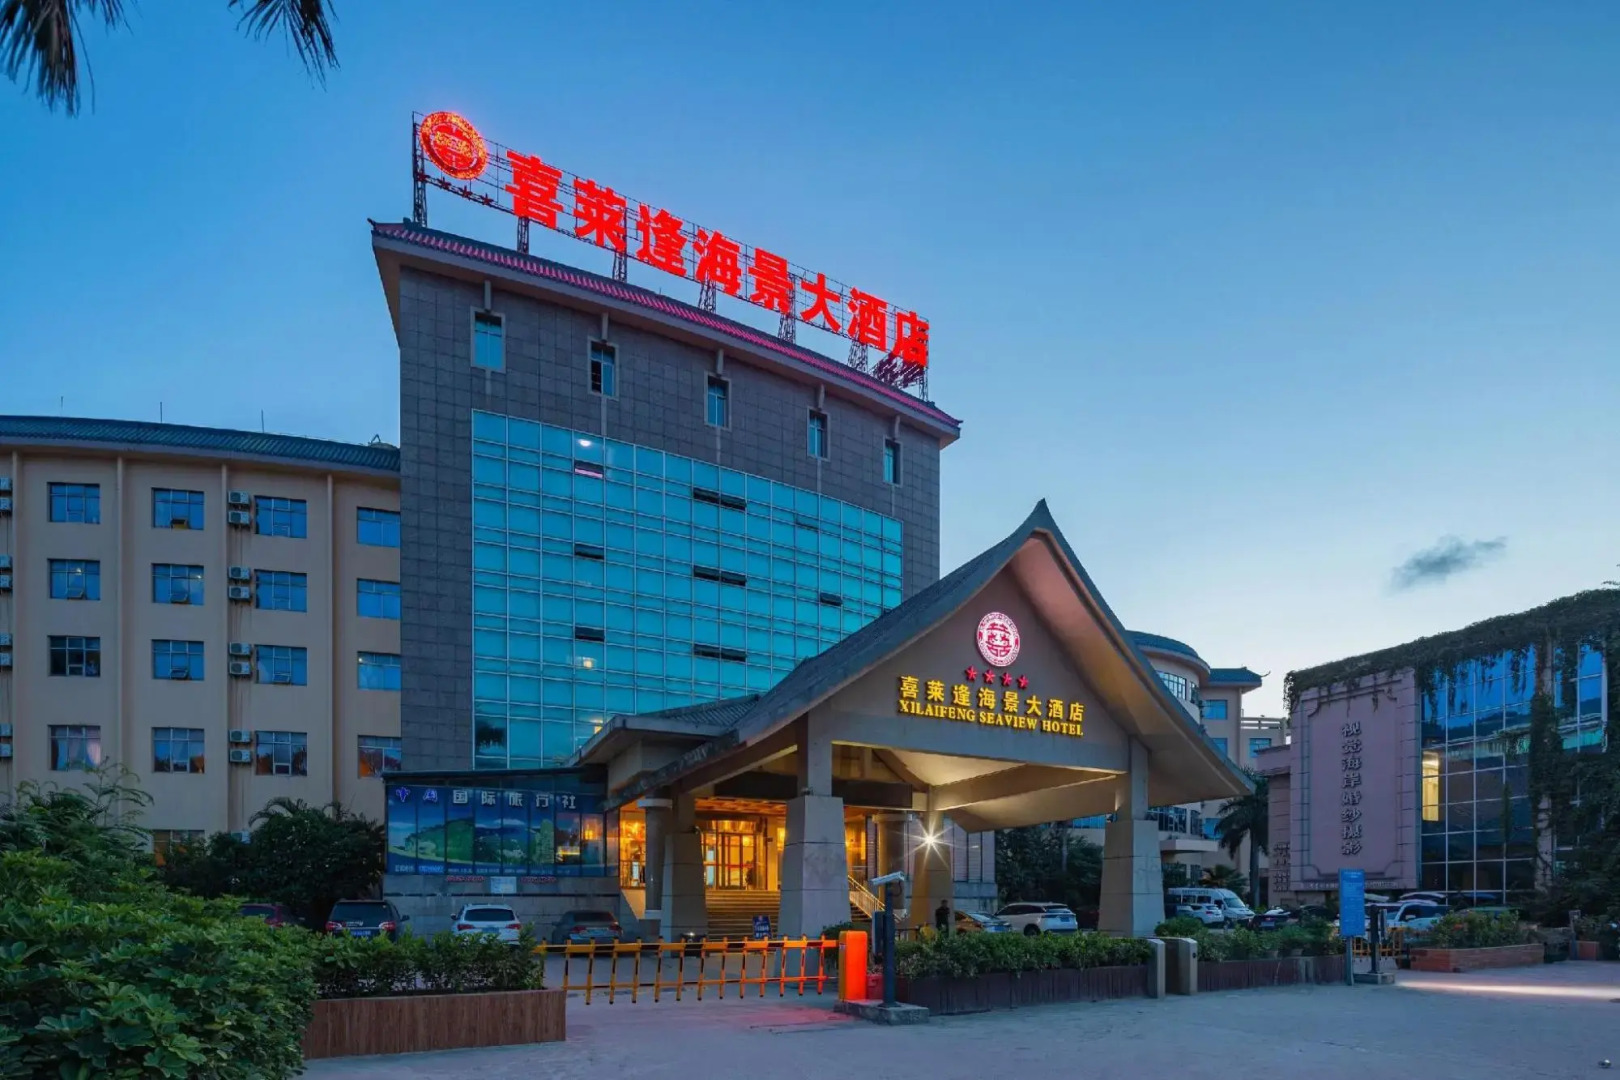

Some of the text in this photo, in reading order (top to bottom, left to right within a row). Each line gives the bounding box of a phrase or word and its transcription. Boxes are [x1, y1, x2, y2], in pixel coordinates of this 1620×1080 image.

[505, 149, 930, 368] 喜莱逢海景大酒店
[898, 699, 1084, 736] XILAIFENG SEAVIEW HOTEL
[899, 675, 1085, 722] 喜莱逢海景大酒店
